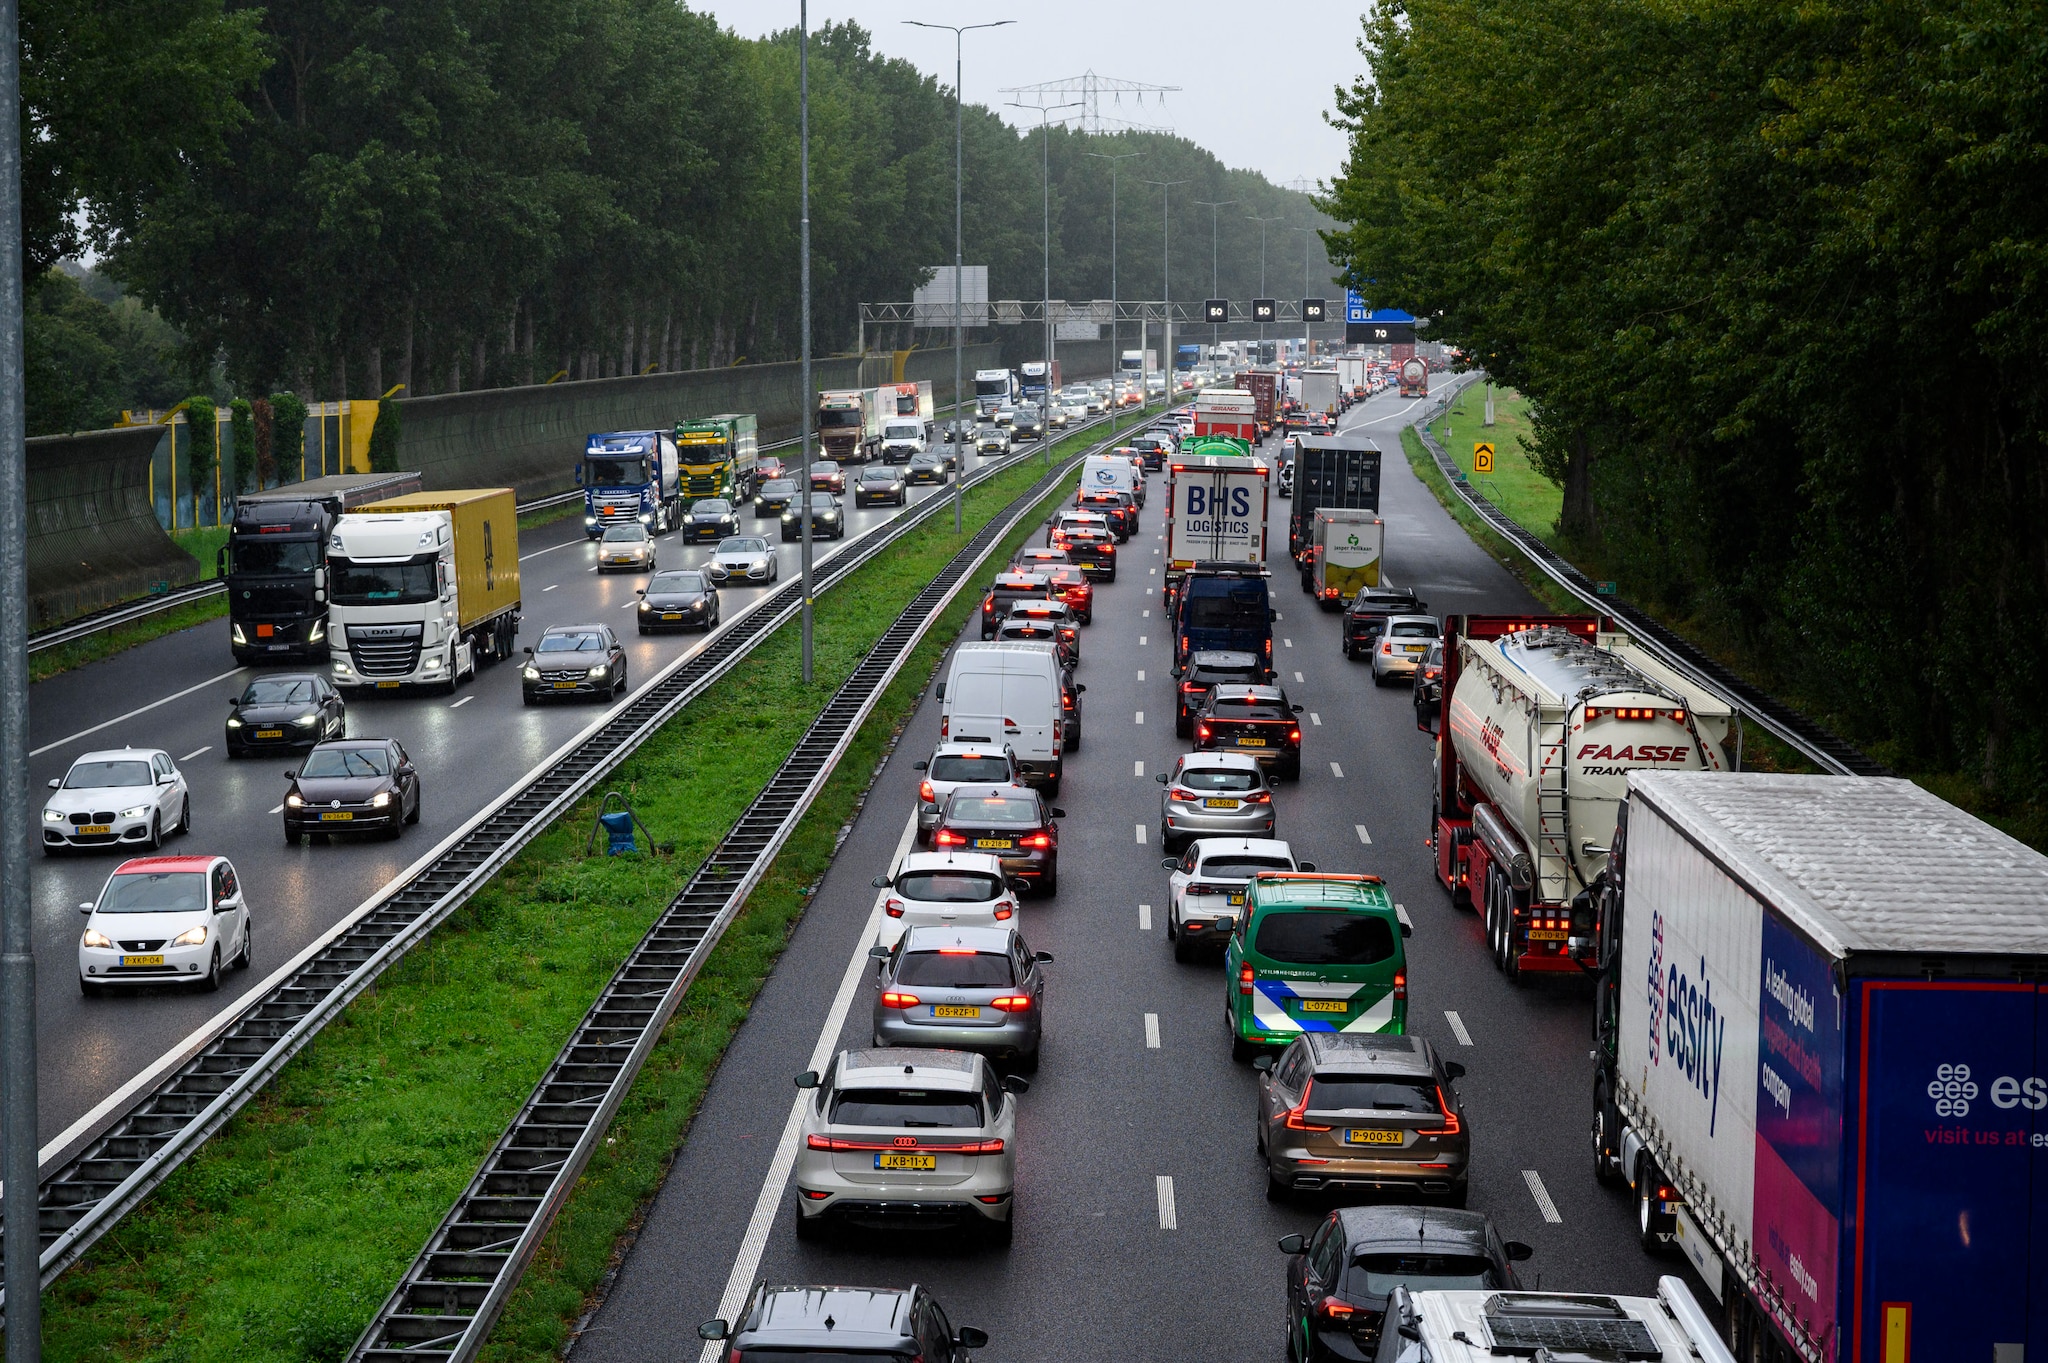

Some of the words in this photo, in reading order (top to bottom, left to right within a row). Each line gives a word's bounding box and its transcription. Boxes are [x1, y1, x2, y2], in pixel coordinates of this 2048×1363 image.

[1210, 308, 1223, 316] 50
[1258, 307, 1271, 316] 50
[1307, 306, 1320, 315] 50
[1374, 329, 1387, 338] 70
[1478, 455, 1489, 468] D
[1187, 485, 1250, 517] BHS
[1186, 520, 1249, 534] LOGISTICS
[1576, 744, 1690, 762] FAASSE
[124, 956, 160, 965] 7-XKP-04
[1771, 960, 1793, 1021] leading
[1793, 984, 1815, 1033] global
[1306, 1001, 1343, 1011] L-072-FL
[938, 1008, 975, 1017] 05-RZF-1
[1667, 955, 1725, 1139] essity
[1762, 1062, 1792, 1120] company
[1353, 1132, 1399, 1142] P-900-SX
[1924, 1124, 1969, 1145] visit
[1975, 1131, 2000, 1145] us
[2004, 1129, 2026, 1146] at
[886, 1156, 929, 1167] JKB-11-X
[1790, 1252, 1818, 1303] essity.com
